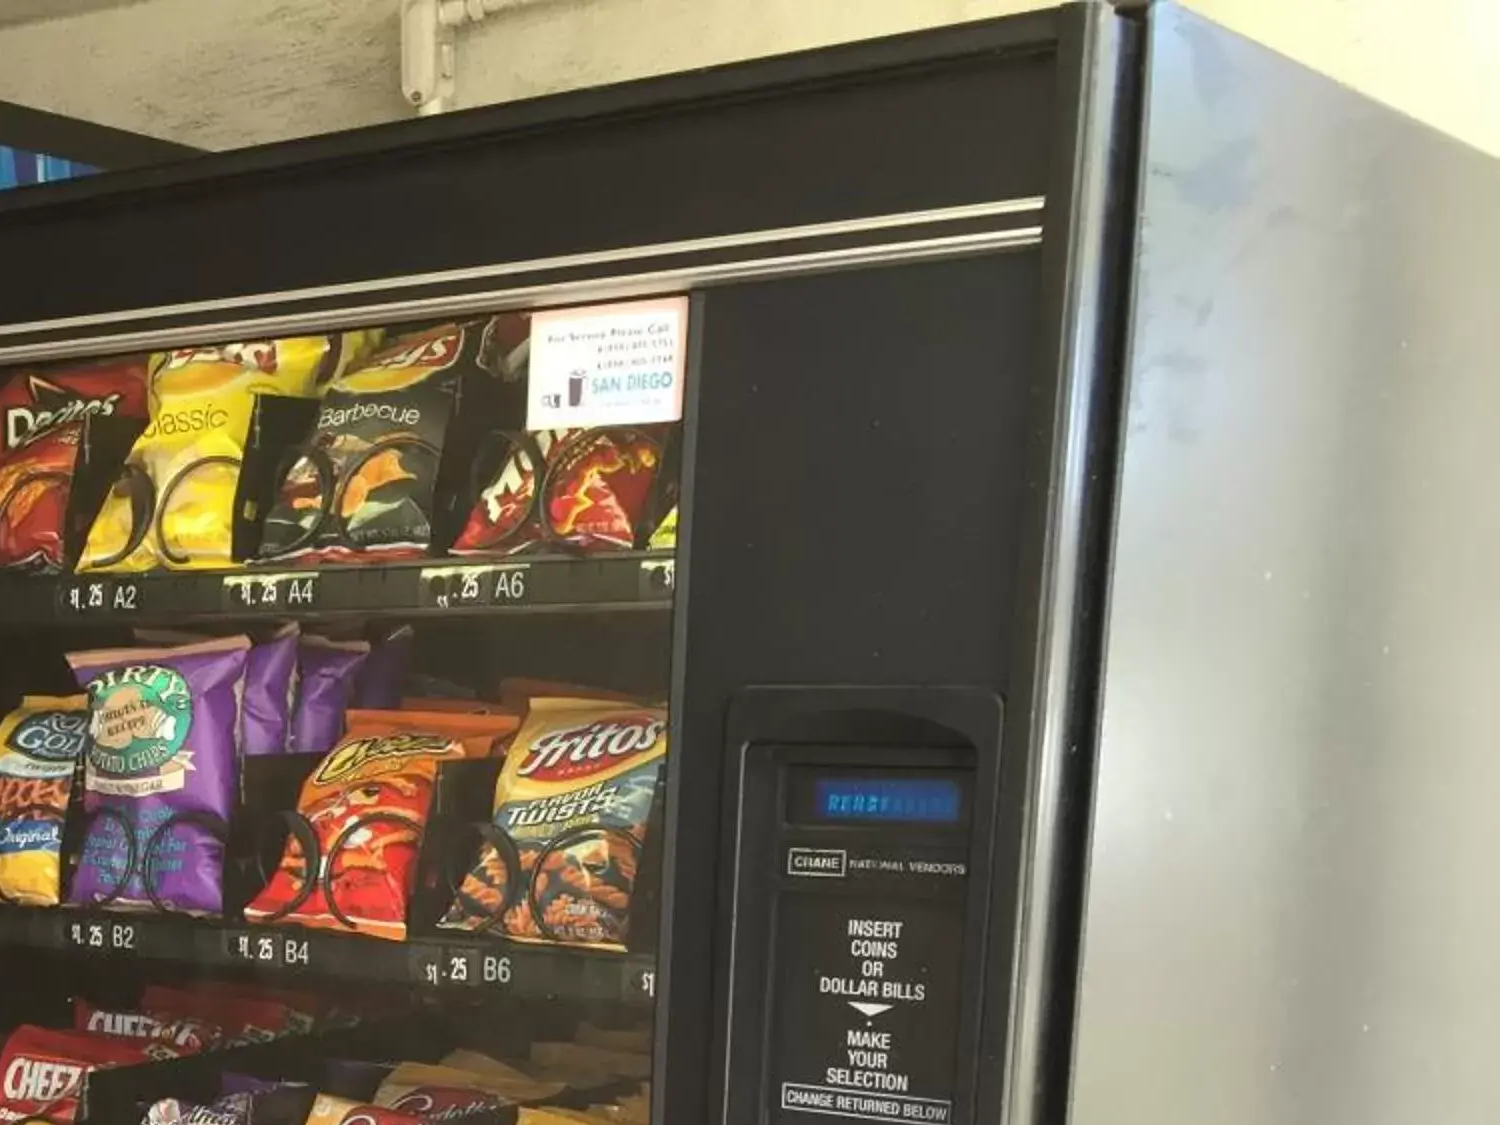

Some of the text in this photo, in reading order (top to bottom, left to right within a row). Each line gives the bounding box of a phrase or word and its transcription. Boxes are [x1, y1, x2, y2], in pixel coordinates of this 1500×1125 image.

[592, 371, 673, 395] SAN DIEGO
[317, 401, 421, 430] Barbecue
[288, 579, 314, 603] A4
[495, 571, 524, 598] A6
[113, 586, 137, 609] A2
[518, 718, 667, 777] Fritos
[908, 861, 966, 875] VENDORS
[113, 926, 135, 949] B2
[848, 919, 903, 939] INSERT
[285, 942, 309, 965] B4
[850, 940, 898, 959] COINS
[483, 957, 512, 984] B6
[861, 960, 884, 977] OR
[819, 977, 926, 1001] DOLLAR BILLS
[847, 1030, 891, 1050] MAKE
[847, 1050, 888, 1069] YOUR
[826, 1068, 908, 1092] SELECTION
[786, 1088, 947, 1122] CHANGE RETURNED BELOW
